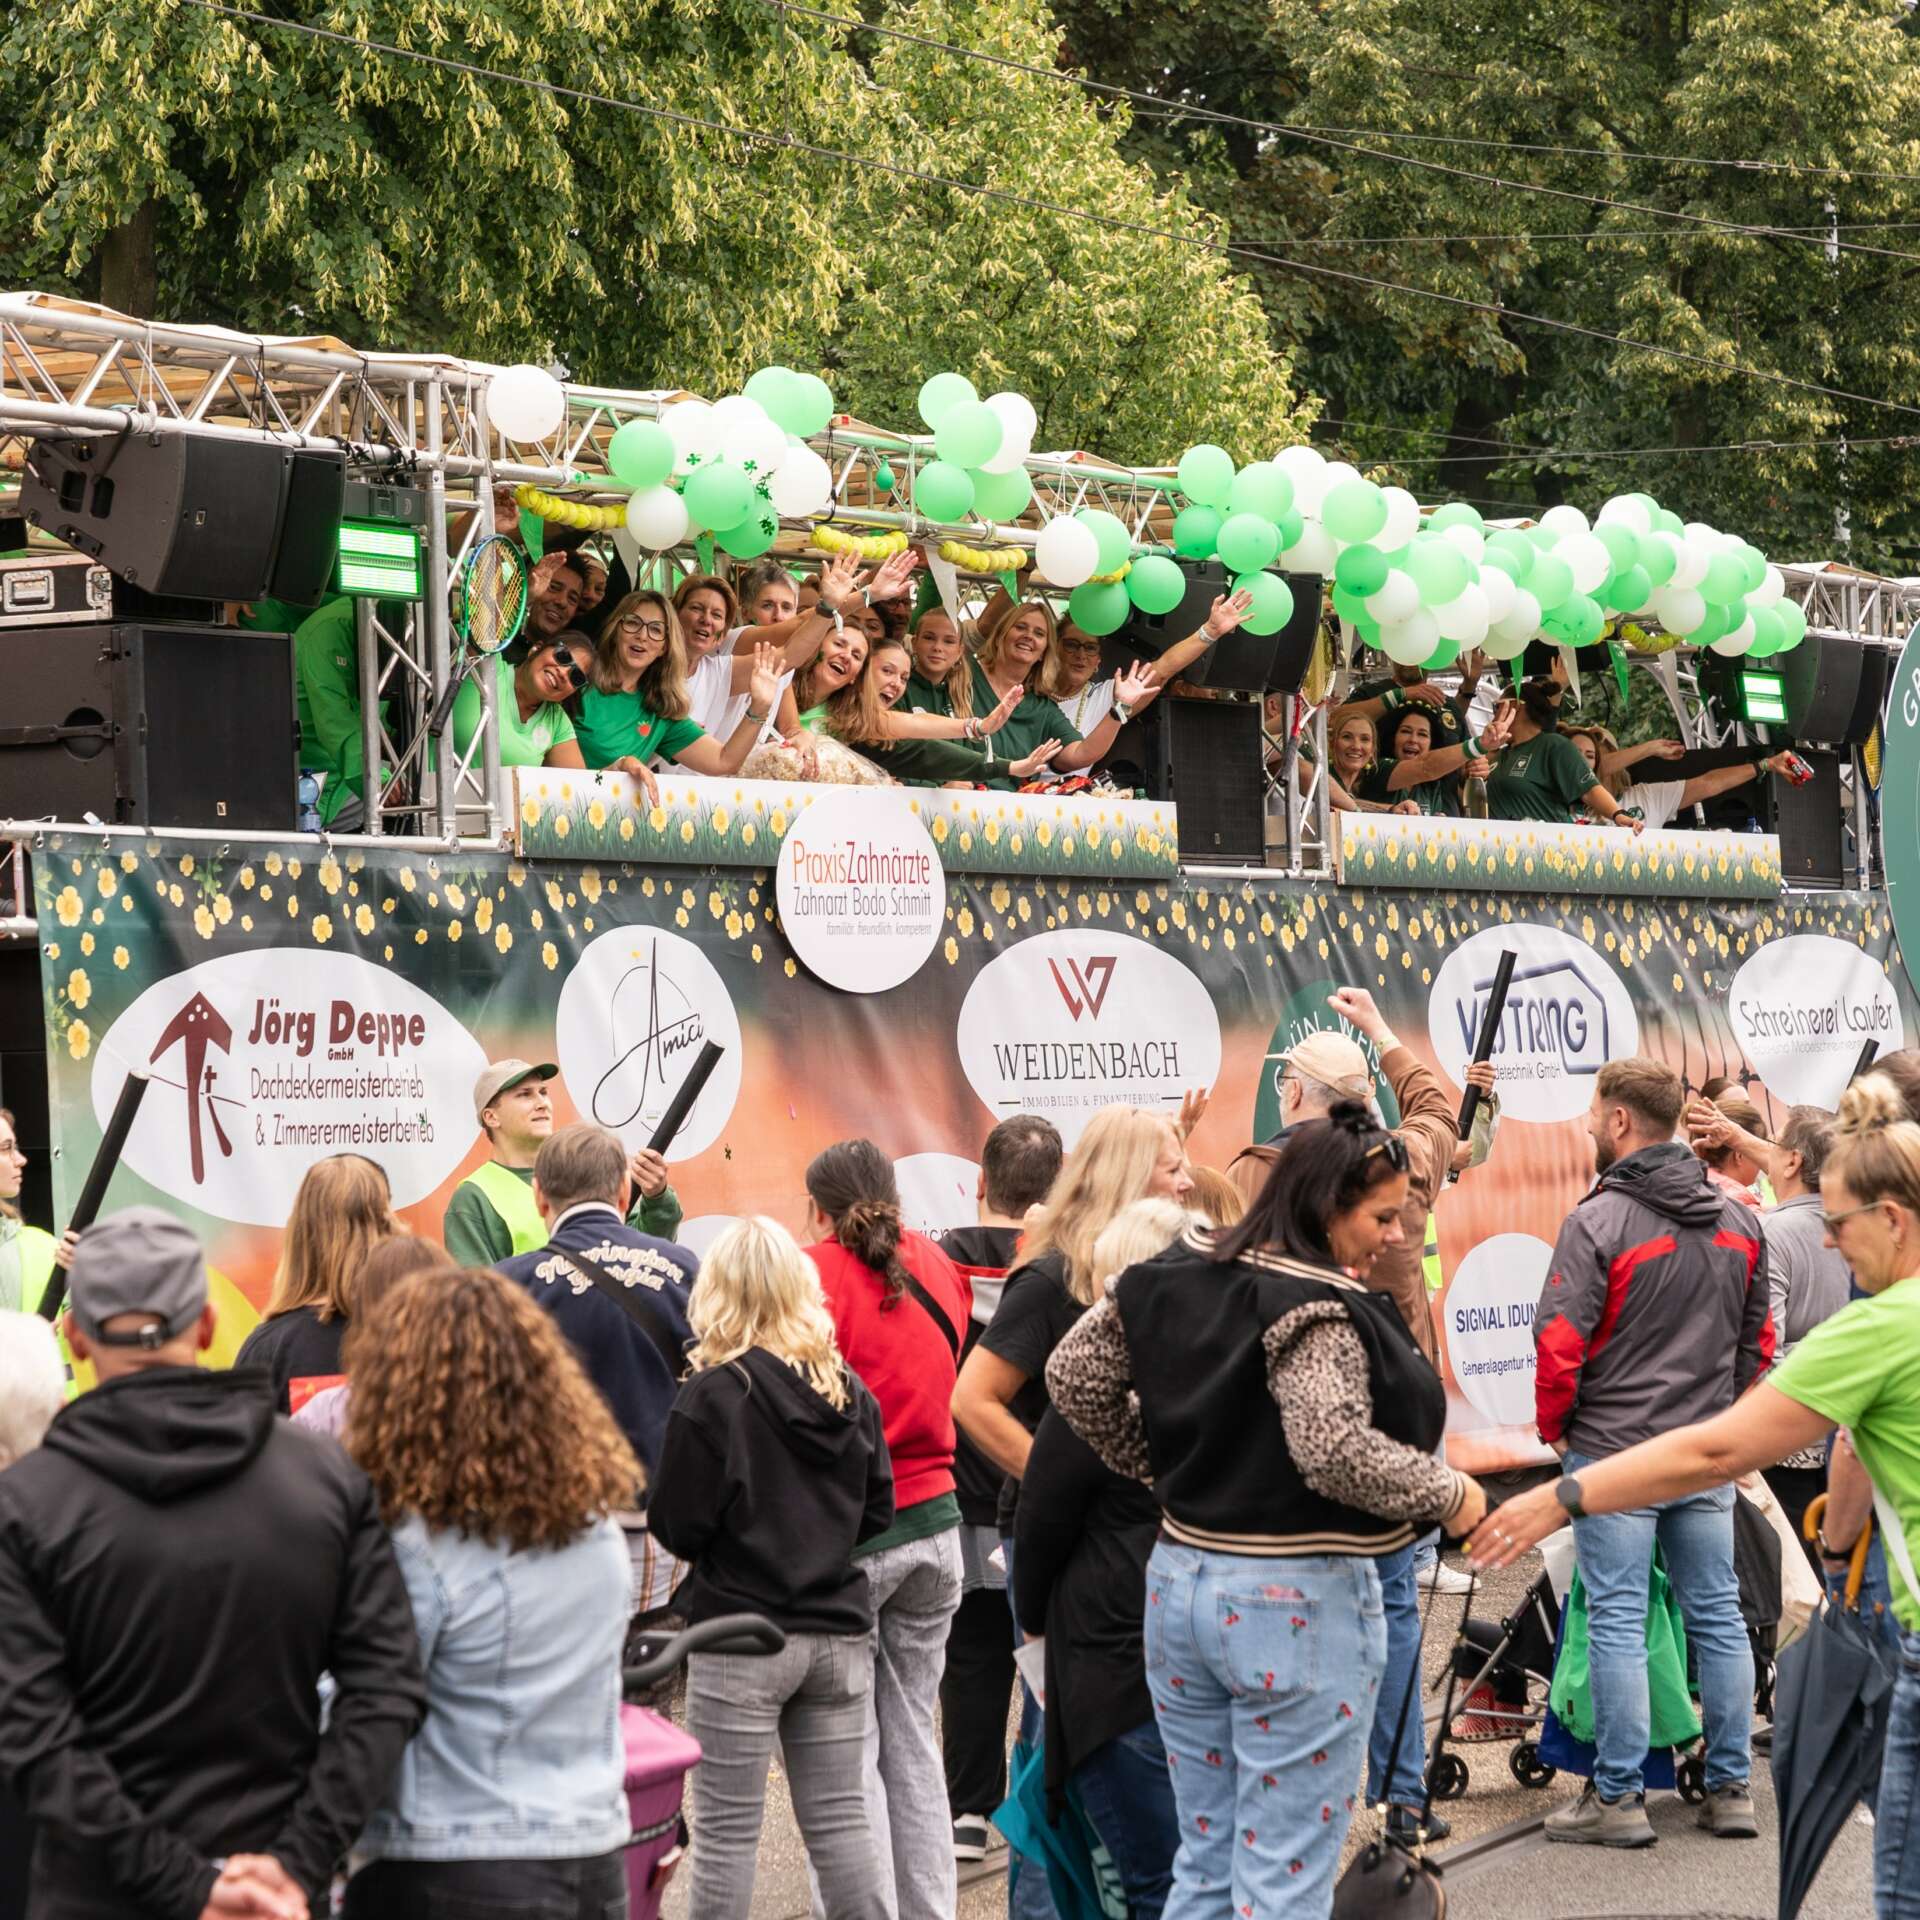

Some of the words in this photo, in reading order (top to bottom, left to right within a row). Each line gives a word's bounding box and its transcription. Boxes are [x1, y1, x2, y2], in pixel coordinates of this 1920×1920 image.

[793, 840, 930, 885] PraxisZahnärzte
[793, 886, 848, 916] Zahnarzt
[852, 886, 886, 916] Bodo
[890, 887, 931, 916] Schmitt
[247, 998, 316, 1058] Jörg
[328, 1000, 426, 1058] Deppe
[1456, 997, 1588, 1057] VTRING
[1739, 1000, 1840, 1038] Schreinerei
[1843, 993, 1894, 1033] Laufer
[327, 1047, 354, 1061] GmbH
[992, 1041, 1181, 1081] WEIDENBACH
[1536, 1062, 1561, 1079] GmbH
[251, 1063, 424, 1100] Dachdeckermeisterbetrieb
[1022, 1095, 1080, 1109] IMMOBILIEN
[256, 1113, 266, 1147] &
[273, 1107, 435, 1147] Zimmerermeisterbetrieb
[1456, 1306, 1505, 1334] SIGNAL
[1462, 1356, 1525, 1377] Generalagentur
